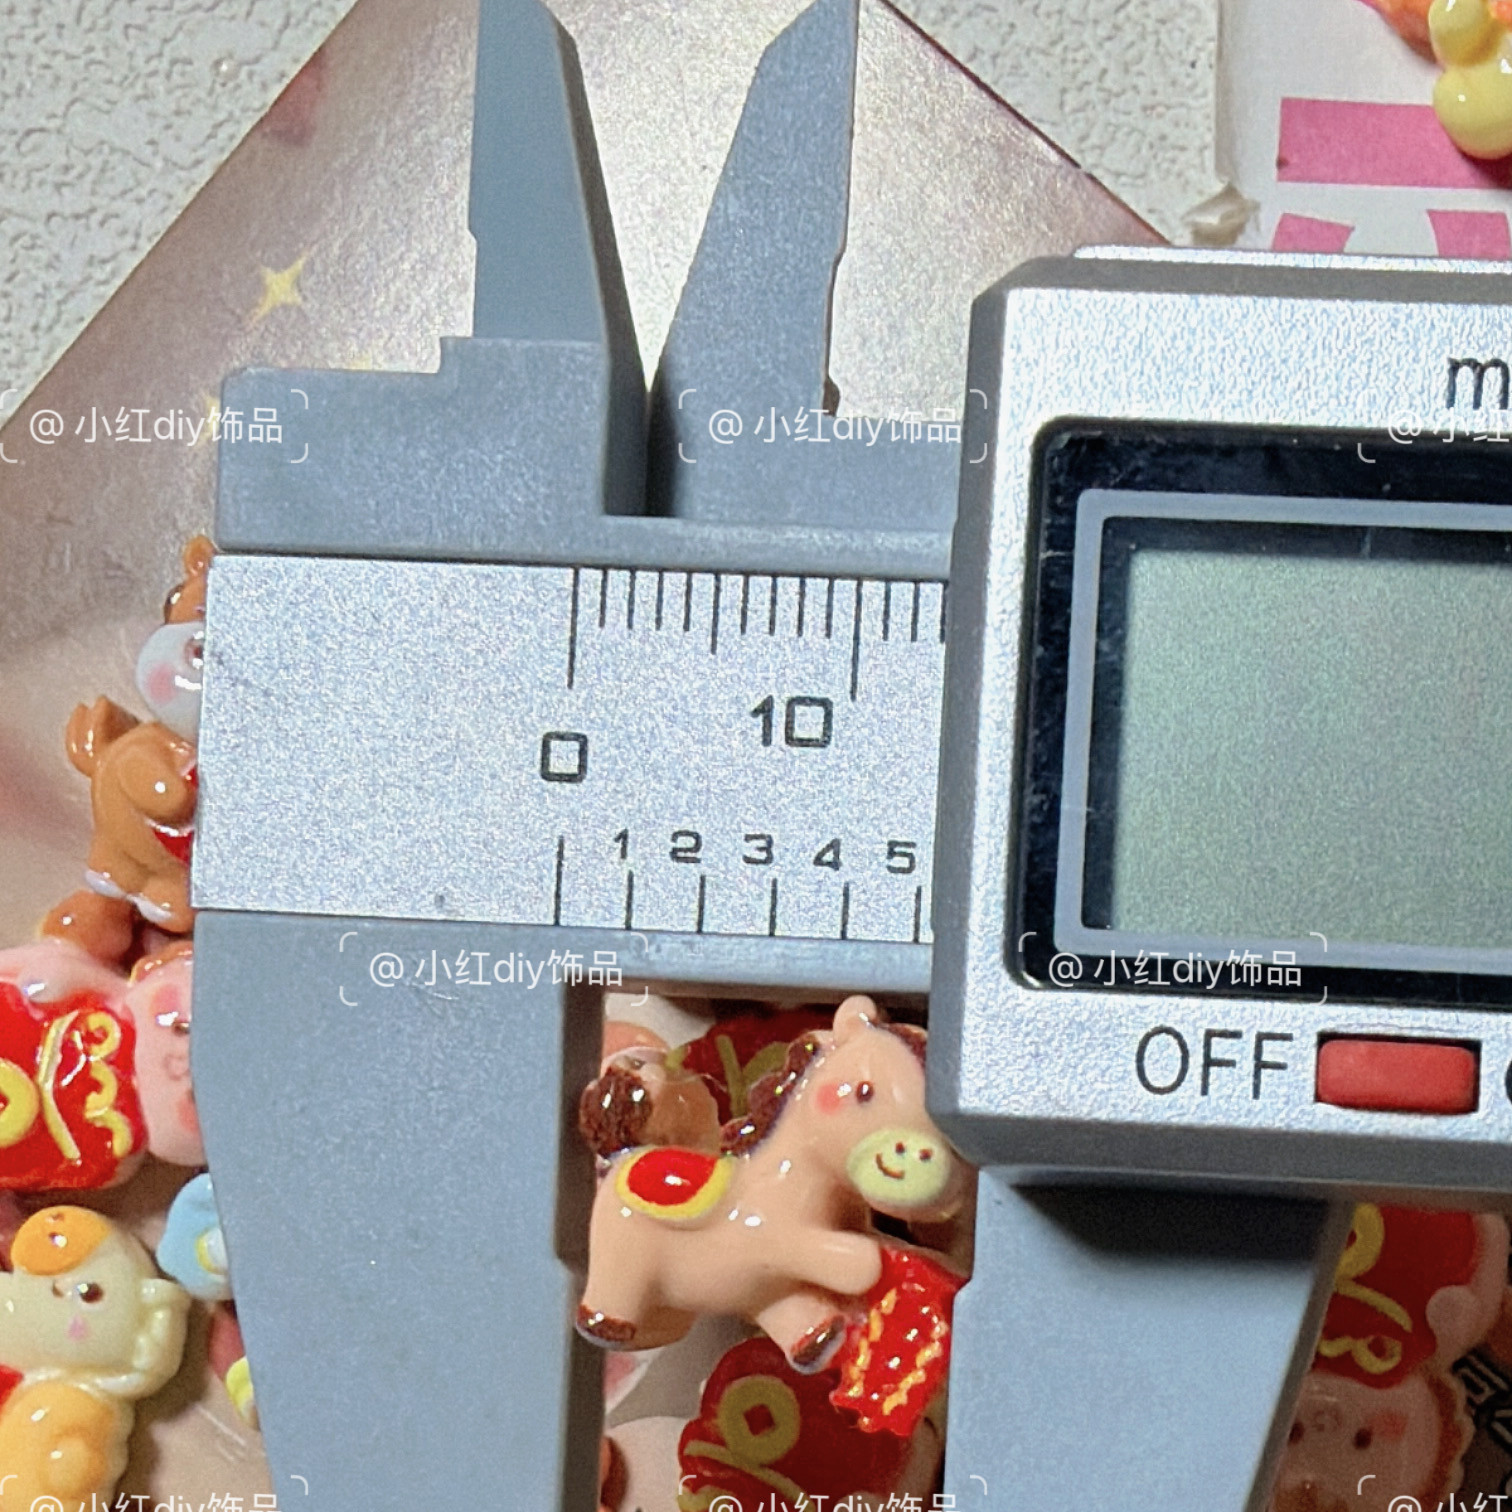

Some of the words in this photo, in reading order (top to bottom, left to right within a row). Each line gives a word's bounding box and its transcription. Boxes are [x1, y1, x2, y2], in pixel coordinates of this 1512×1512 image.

[540, 731, 590, 784] 0
[750, 694, 834, 750] 10
[614, 828, 629, 861] 1
[669, 829, 703, 864] 2
[743, 832, 776, 866] 3
[813, 836, 843, 872] 4
[884, 839, 918, 875] 5
[1133, 1025, 1294, 1102] OFF
